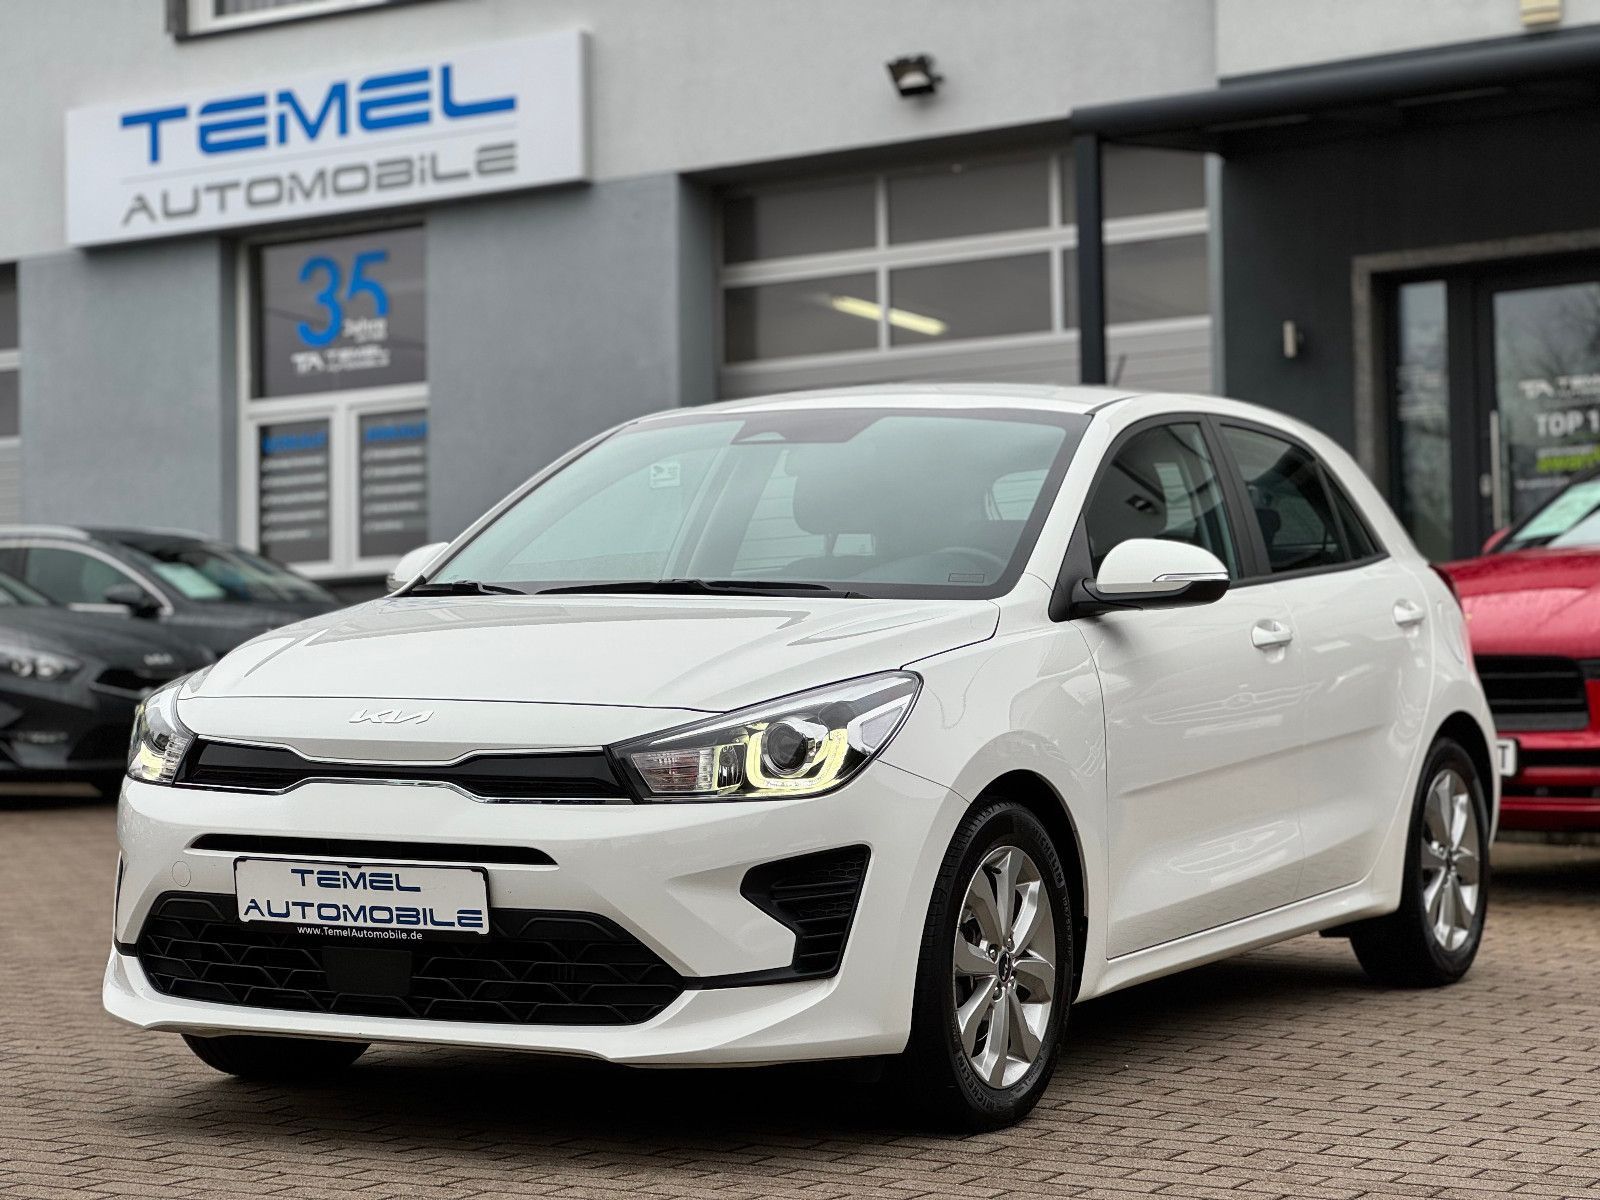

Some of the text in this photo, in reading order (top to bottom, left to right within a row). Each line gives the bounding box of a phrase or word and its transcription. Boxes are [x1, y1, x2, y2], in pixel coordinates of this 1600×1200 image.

[121, 64, 517, 166] TEMEL
[297, 251, 389, 348] 35
[1536, 410, 1584, 437] TOP
[291, 868, 421, 892] TEMEL
[244, 899, 483, 927] AUTOMOBILE
[297, 926, 423, 940] www.TemelAutomobile.de
